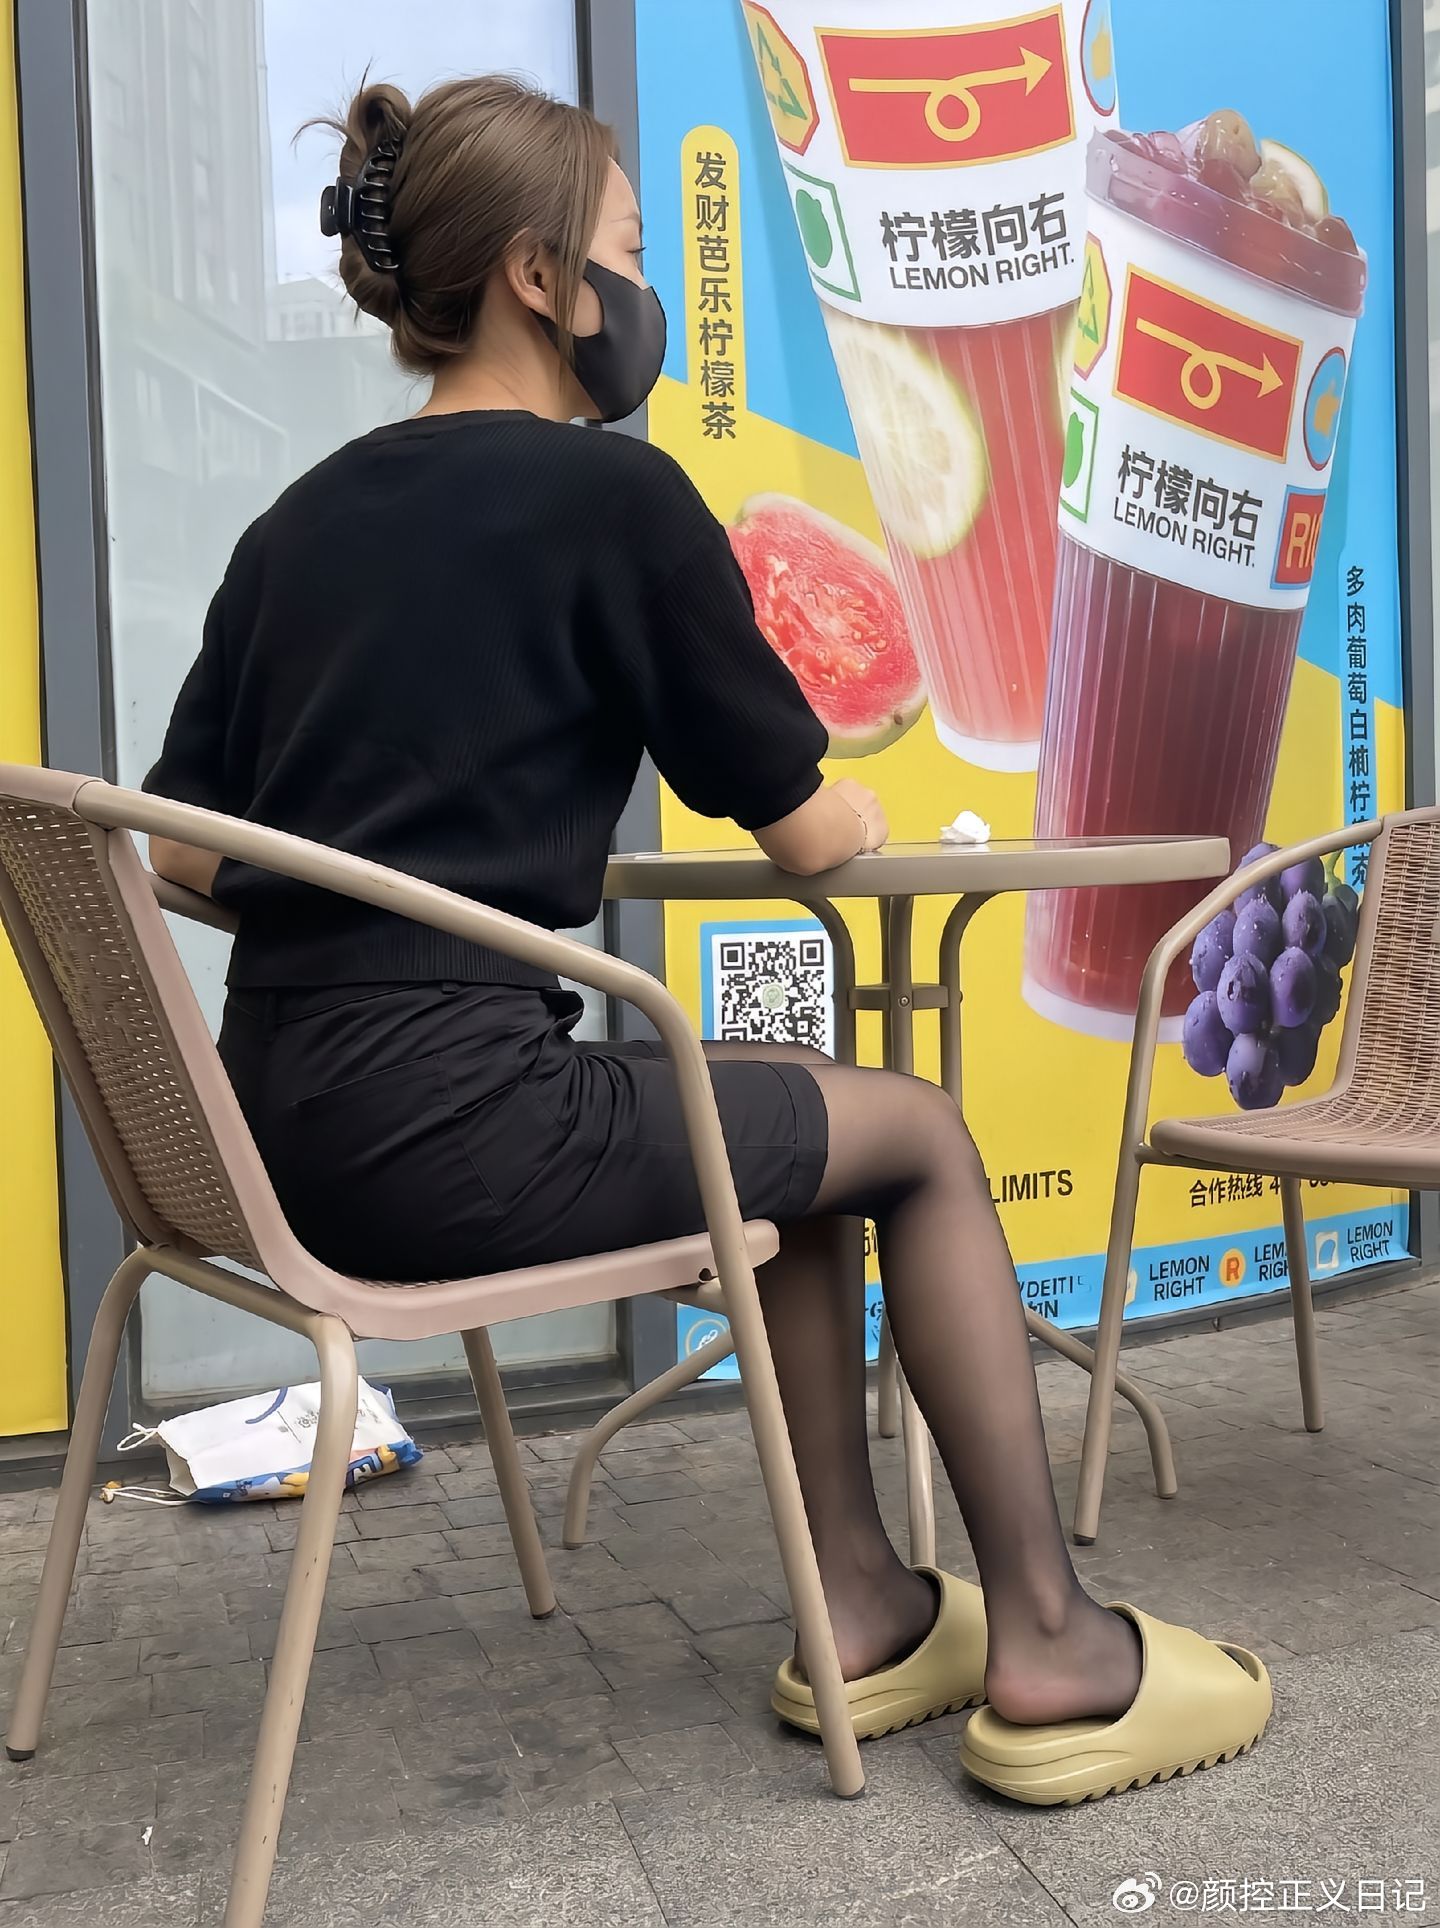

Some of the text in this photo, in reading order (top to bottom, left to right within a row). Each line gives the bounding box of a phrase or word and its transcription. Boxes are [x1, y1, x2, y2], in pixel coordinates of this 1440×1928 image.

[879, 192, 1067, 262] 柠檬向右
[889, 242, 1075, 290] LEMON RIGHT.
[694, 151, 737, 440] 发财芭乐柠檬茶
[1117, 444, 1263, 542] 柠檬向右
[1113, 497, 1256, 569] LEMON RIGHT.
[1189, 1174, 1263, 1208] 合作热线
[1347, 1219, 1394, 1245] LEMON
[1254, 1241, 1288, 1263] LEM
[1350, 1240, 1390, 1263] RIGHT
[1149, 1255, 1210, 1282] LEMON
[1226, 1256, 1240, 1282] R
[1154, 1276, 1205, 1301] RIGHT
